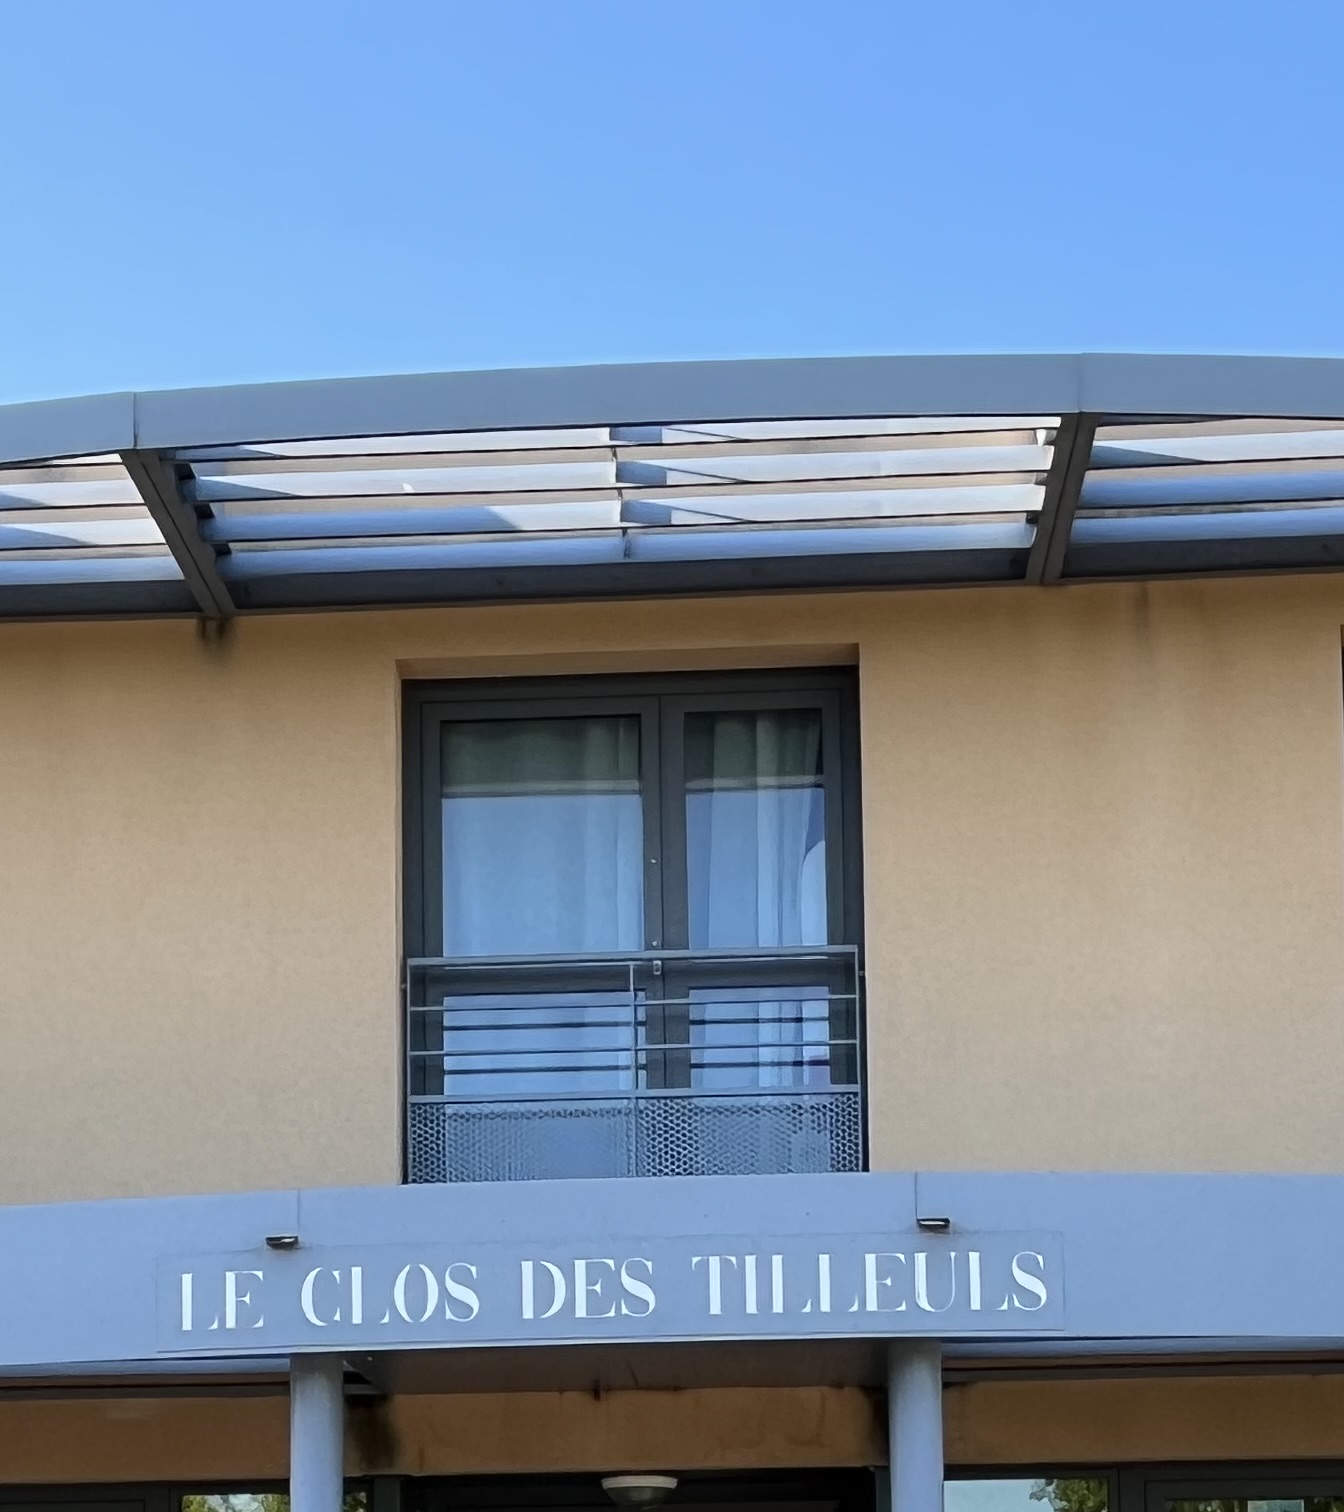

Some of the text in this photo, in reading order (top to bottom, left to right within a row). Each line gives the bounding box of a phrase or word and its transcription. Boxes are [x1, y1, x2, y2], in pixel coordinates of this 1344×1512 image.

[180, 1250, 1048, 1331] LE CLOS DES TILLEULS
